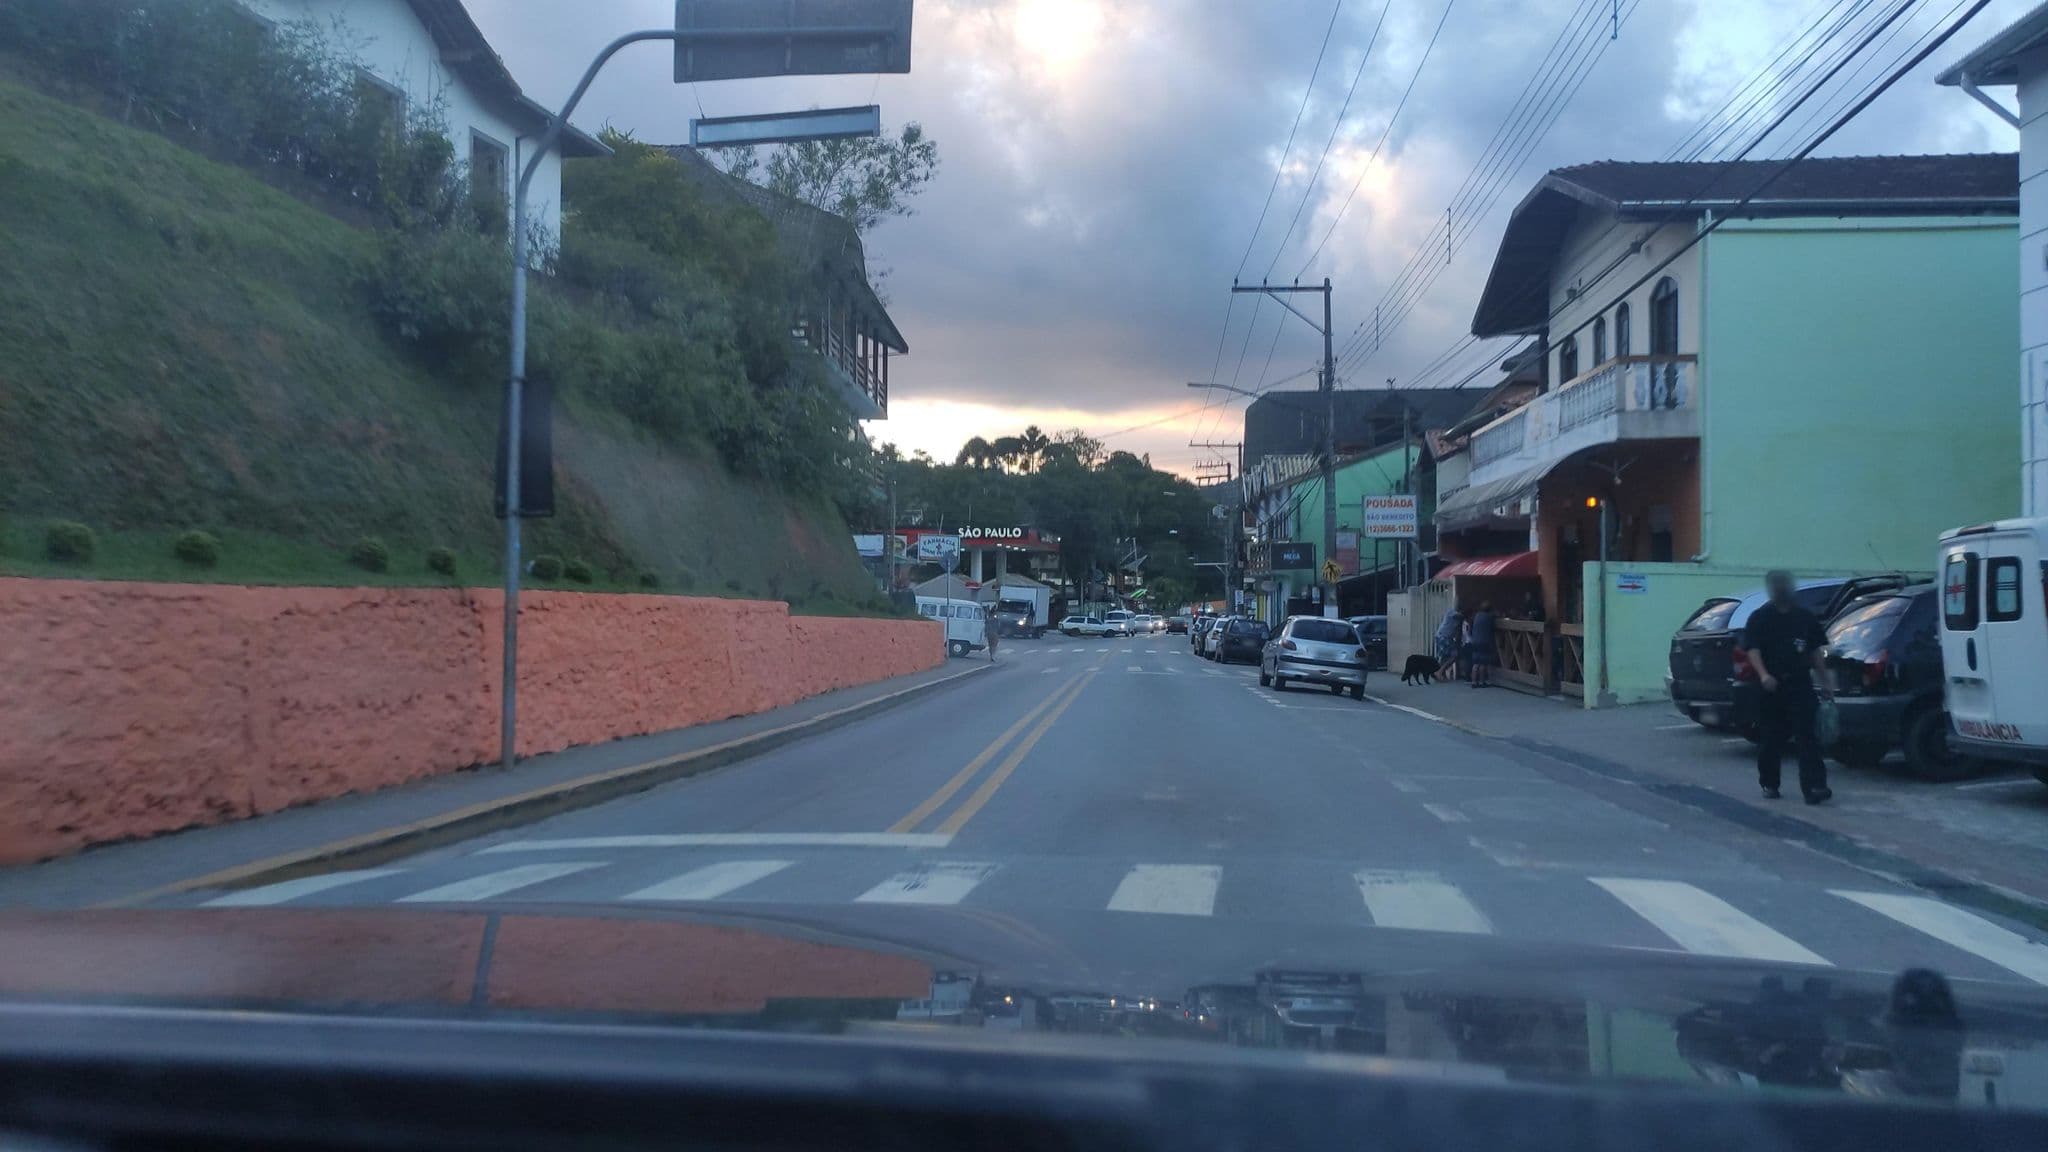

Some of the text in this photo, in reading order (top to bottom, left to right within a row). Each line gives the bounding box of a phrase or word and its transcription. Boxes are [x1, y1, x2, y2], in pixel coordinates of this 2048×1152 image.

[1366, 499, 1413, 508] POUSADA
[958, 525, 1022, 538] SÃO PAULO
